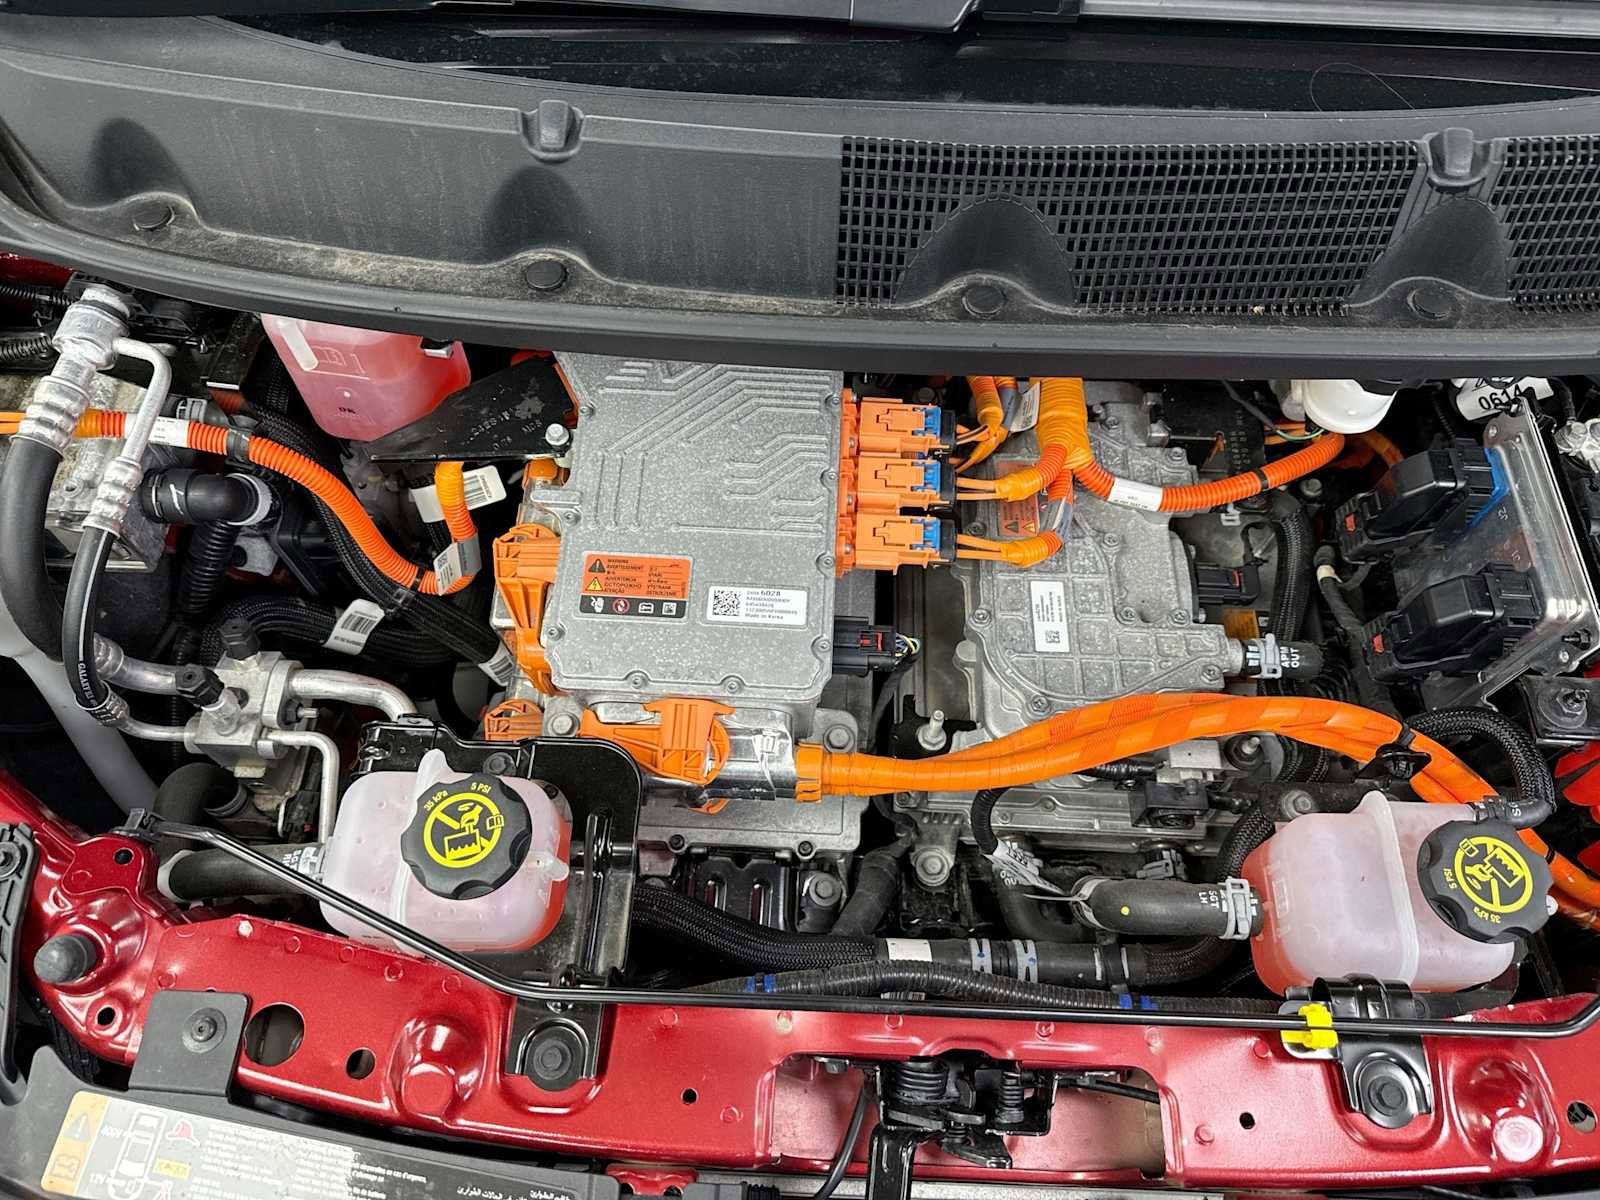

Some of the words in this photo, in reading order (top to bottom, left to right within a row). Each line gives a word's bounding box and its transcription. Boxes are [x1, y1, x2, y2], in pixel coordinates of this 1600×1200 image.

[1290, 647, 1300, 668] OUT
[471, 782, 477, 791] 5
[477, 783, 492, 794] PSI
[423, 802, 436, 812] 35
[432, 790, 449, 804] kPa
[1443, 868, 1455, 882] PSI
[1198, 891, 1208, 904] LH
[1208, 890, 1220, 909] SGT
[1473, 906, 1490, 921] kPa
[1489, 913, 1502, 924] 35
[89, 1173, 107, 1185] 12V
